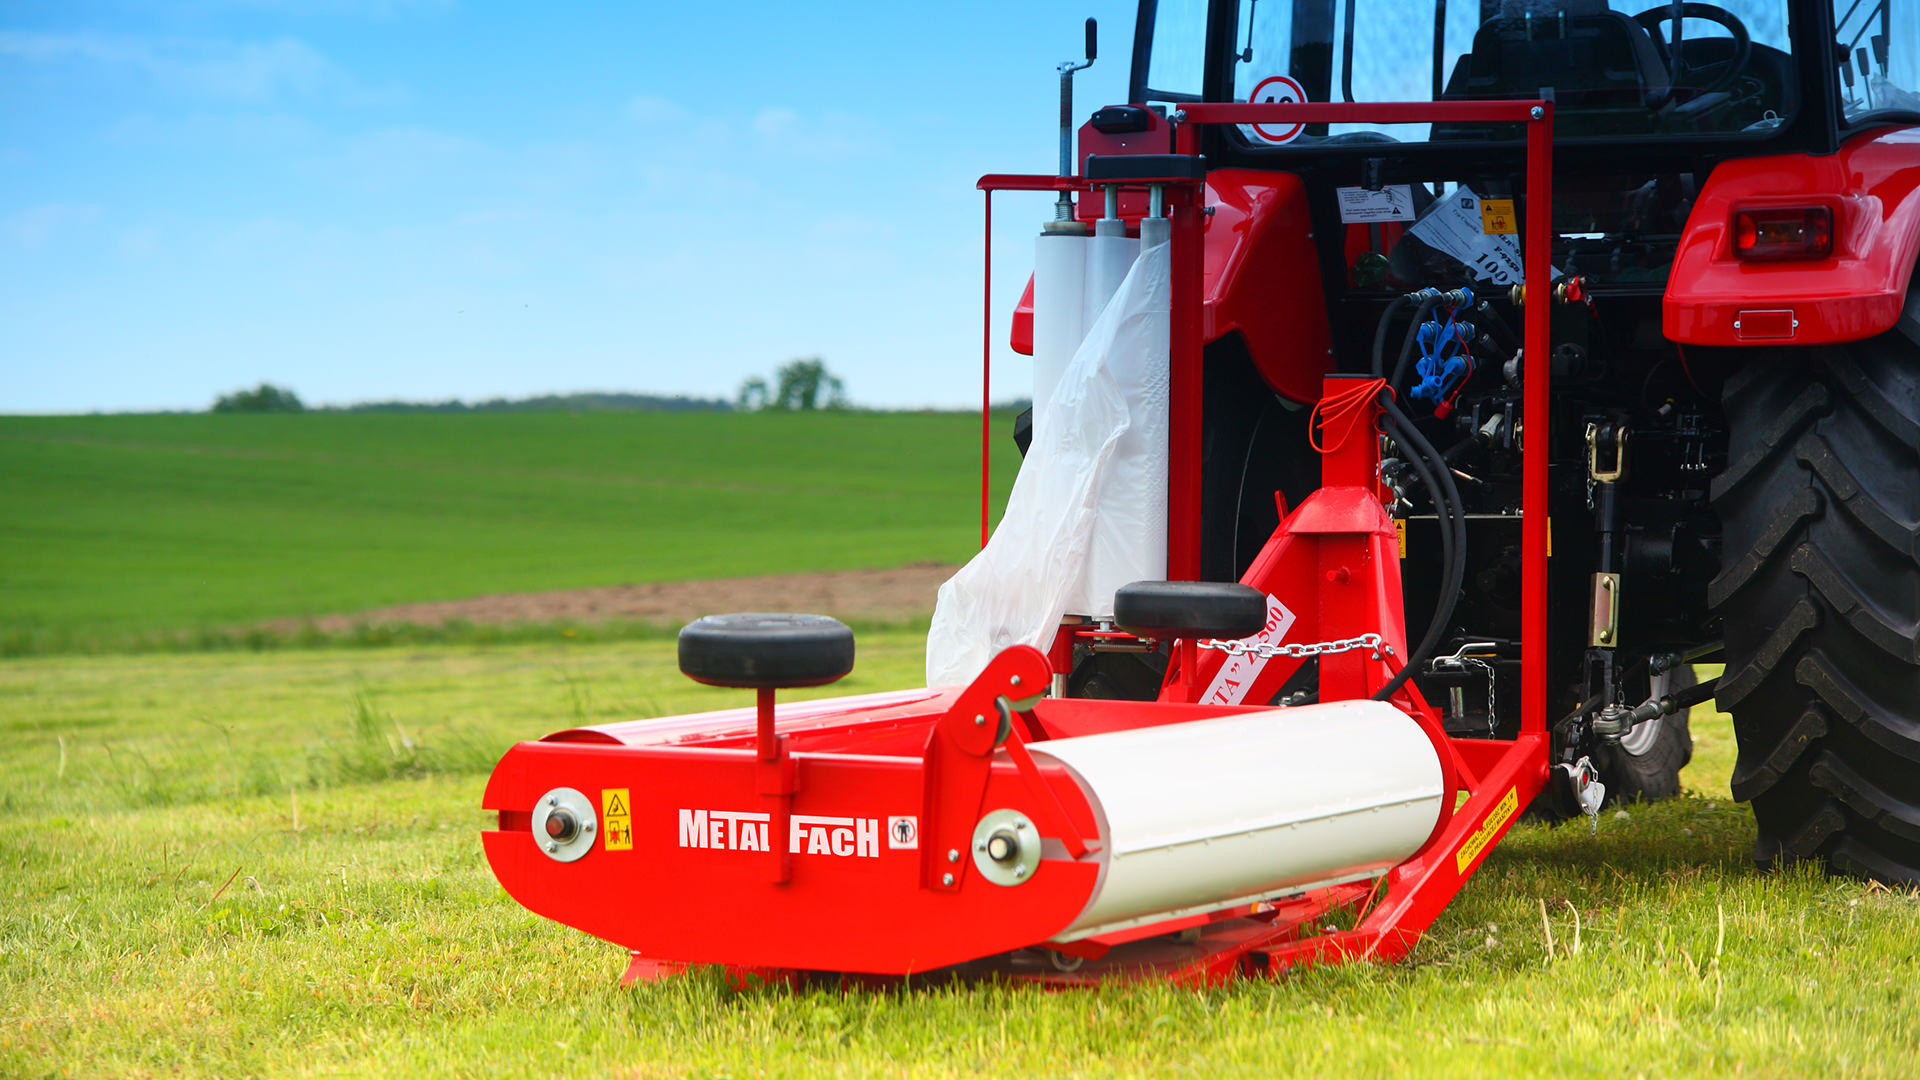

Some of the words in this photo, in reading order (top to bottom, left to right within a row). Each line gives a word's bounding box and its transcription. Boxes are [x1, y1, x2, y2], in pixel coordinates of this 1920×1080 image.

[1475, 253, 1508, 282] 100
[679, 808, 770, 852] METAL
[789, 814, 879, 858] FACH
